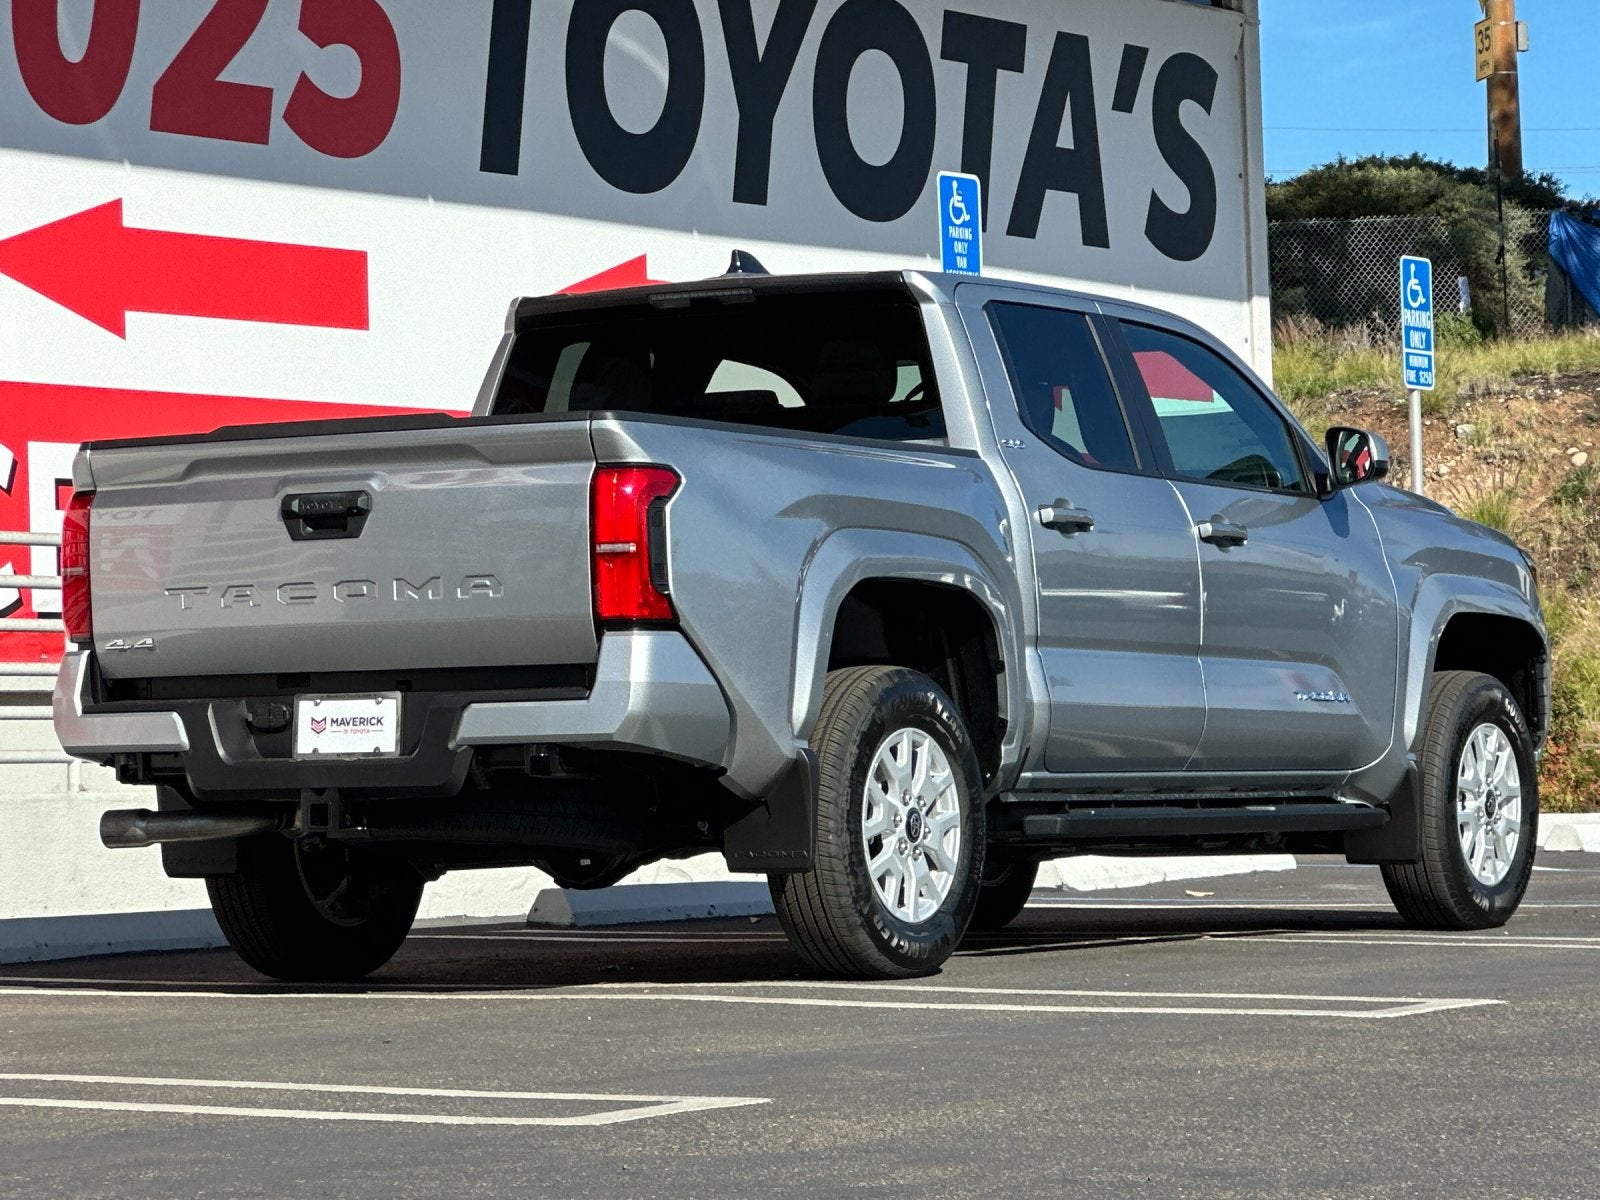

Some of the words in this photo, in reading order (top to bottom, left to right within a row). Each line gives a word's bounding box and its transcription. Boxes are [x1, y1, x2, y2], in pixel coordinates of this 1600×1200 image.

[1478, 26, 1491, 54] 35
[949, 226, 973, 240] PARKING
[954, 241, 968, 255] ONLY
[956, 255, 968, 268] VAN
[1404, 308, 1431, 329] PARKING
[1409, 329, 1426, 349] ONLY
[163, 574, 503, 610] TACOMA
[330, 716, 384, 727] MAVERICK
